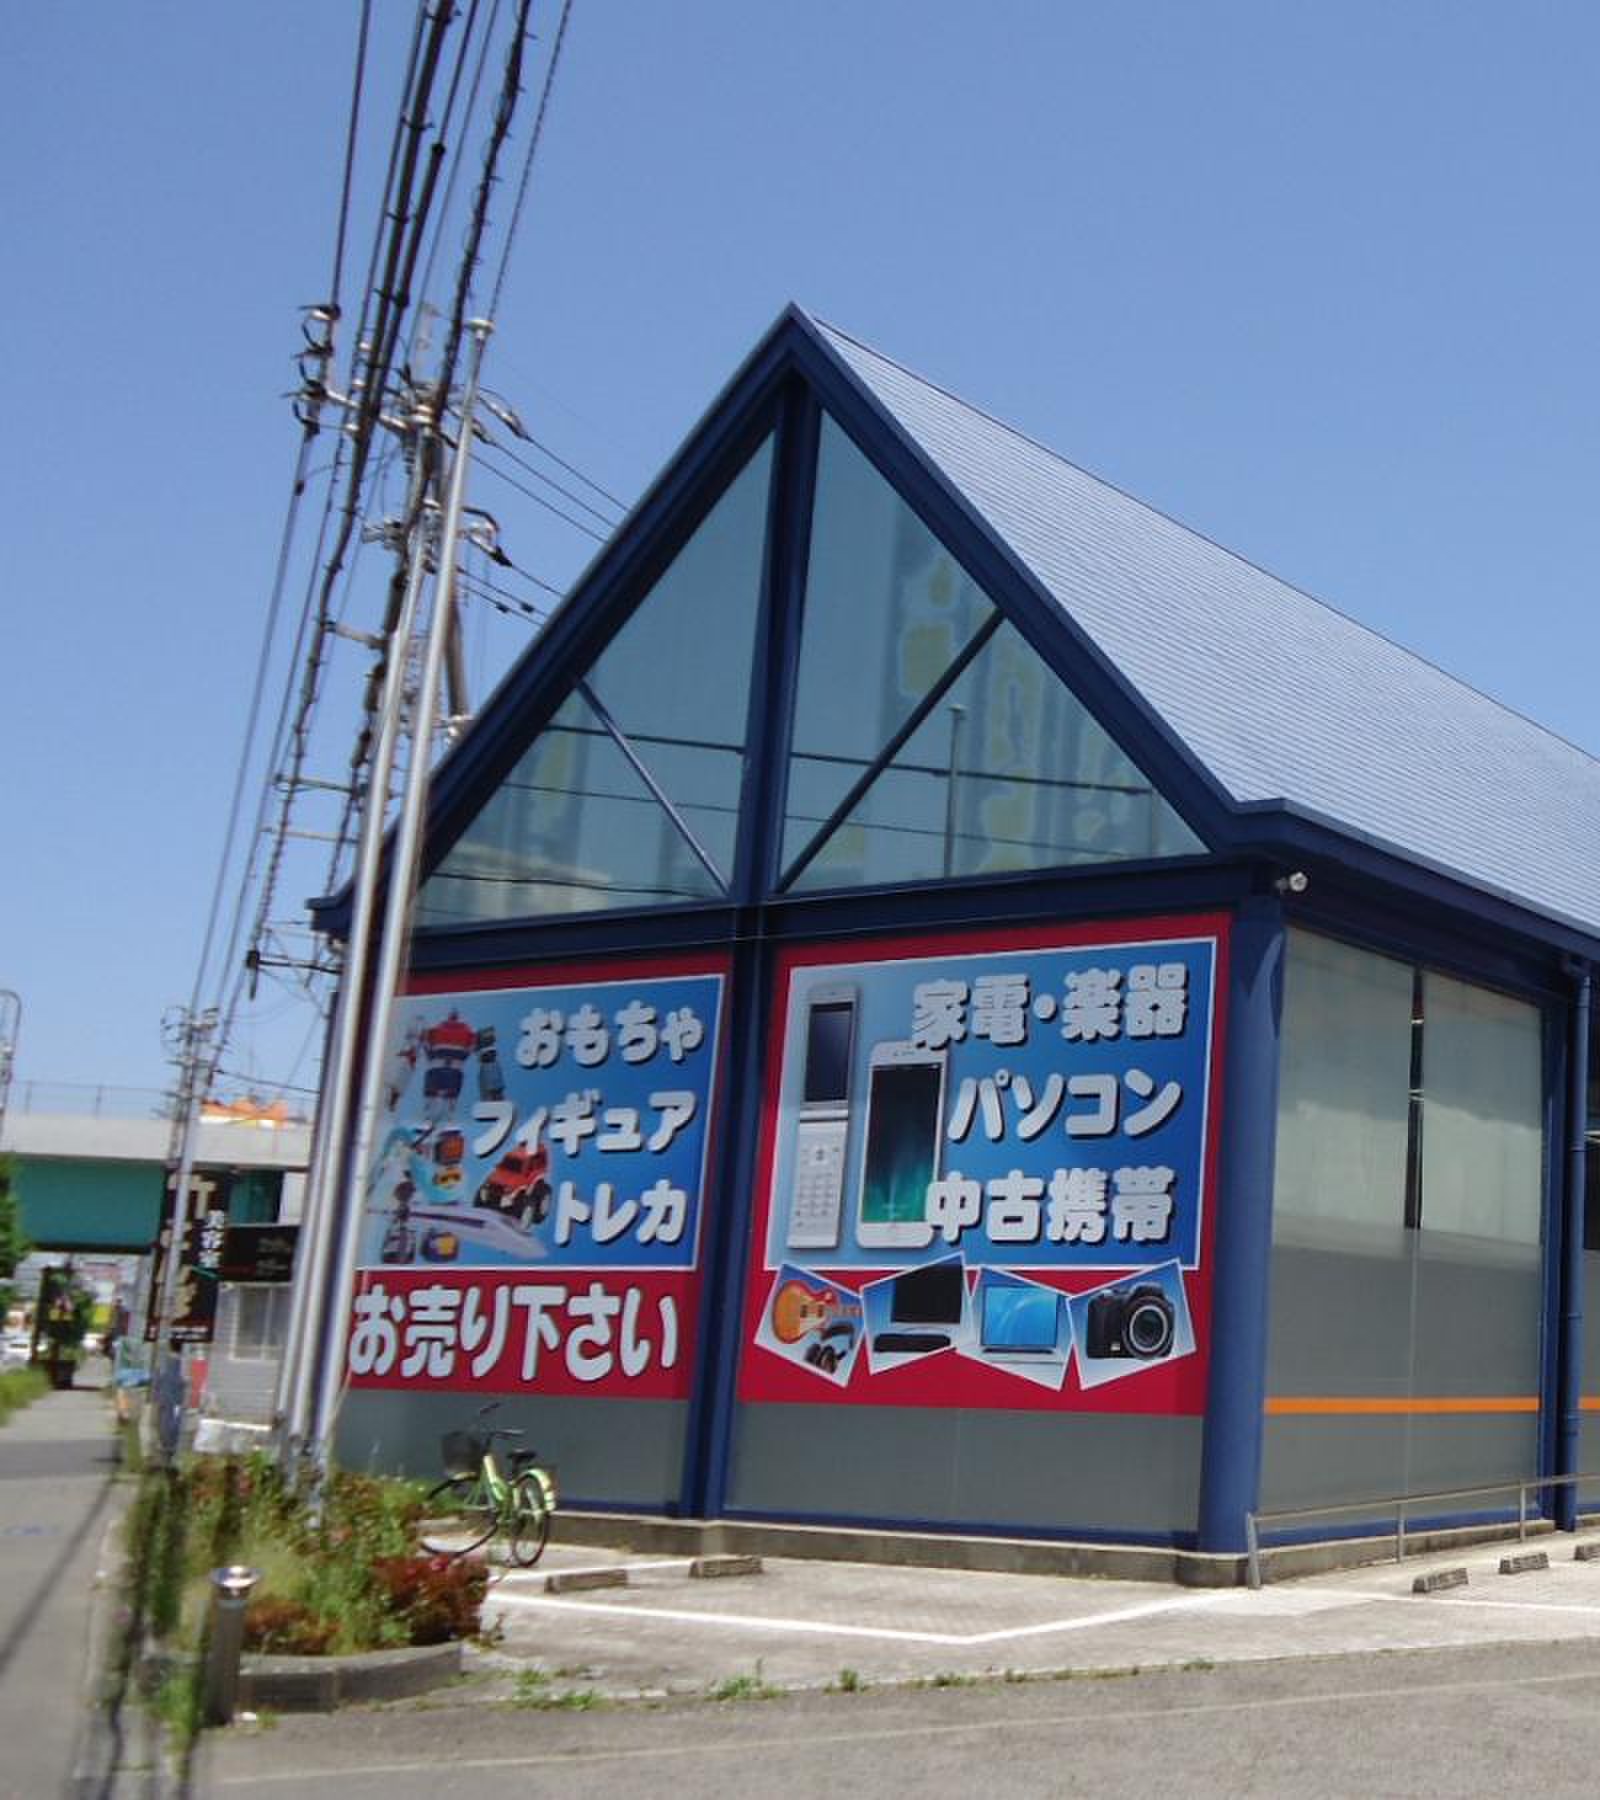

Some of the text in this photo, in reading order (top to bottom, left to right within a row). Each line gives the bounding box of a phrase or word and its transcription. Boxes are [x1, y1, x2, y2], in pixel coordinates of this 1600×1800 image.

[516, 999, 704, 1069] おもちゃ
[912, 962, 1187, 1050] 家電・楽器
[472, 1088, 697, 1157] フィギュア
[947, 1067, 1183, 1141] パソコン
[553, 1178, 688, 1245] トレカ
[925, 1165, 1176, 1243] 中古携帯
[348, 1281, 679, 1382] お売り下さい
